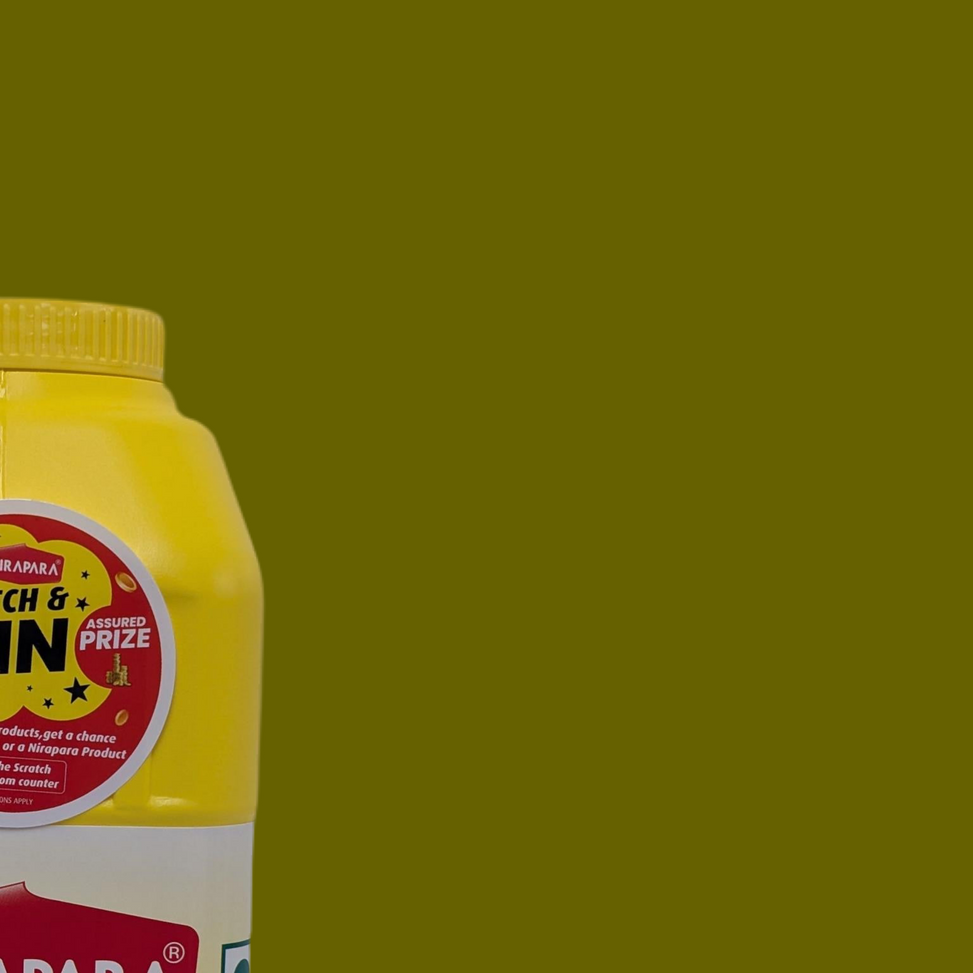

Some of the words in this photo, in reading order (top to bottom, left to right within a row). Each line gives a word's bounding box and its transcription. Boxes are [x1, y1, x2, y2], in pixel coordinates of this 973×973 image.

[47, 586, 69, 611] &
[86, 616, 146, 629] ASSURED
[79, 628, 151, 651] PRIZE
[66, 732, 73, 740] a
[76, 731, 116, 743] chance
[2, 743, 15, 751] or
[17, 744, 25, 752] a
[28, 743, 79, 757] Nirapara
[82, 747, 127, 759] Product
[13, 763, 51, 774] Scratch
[18, 778, 59, 789] counter
[13, 797, 33, 805] APPLY
